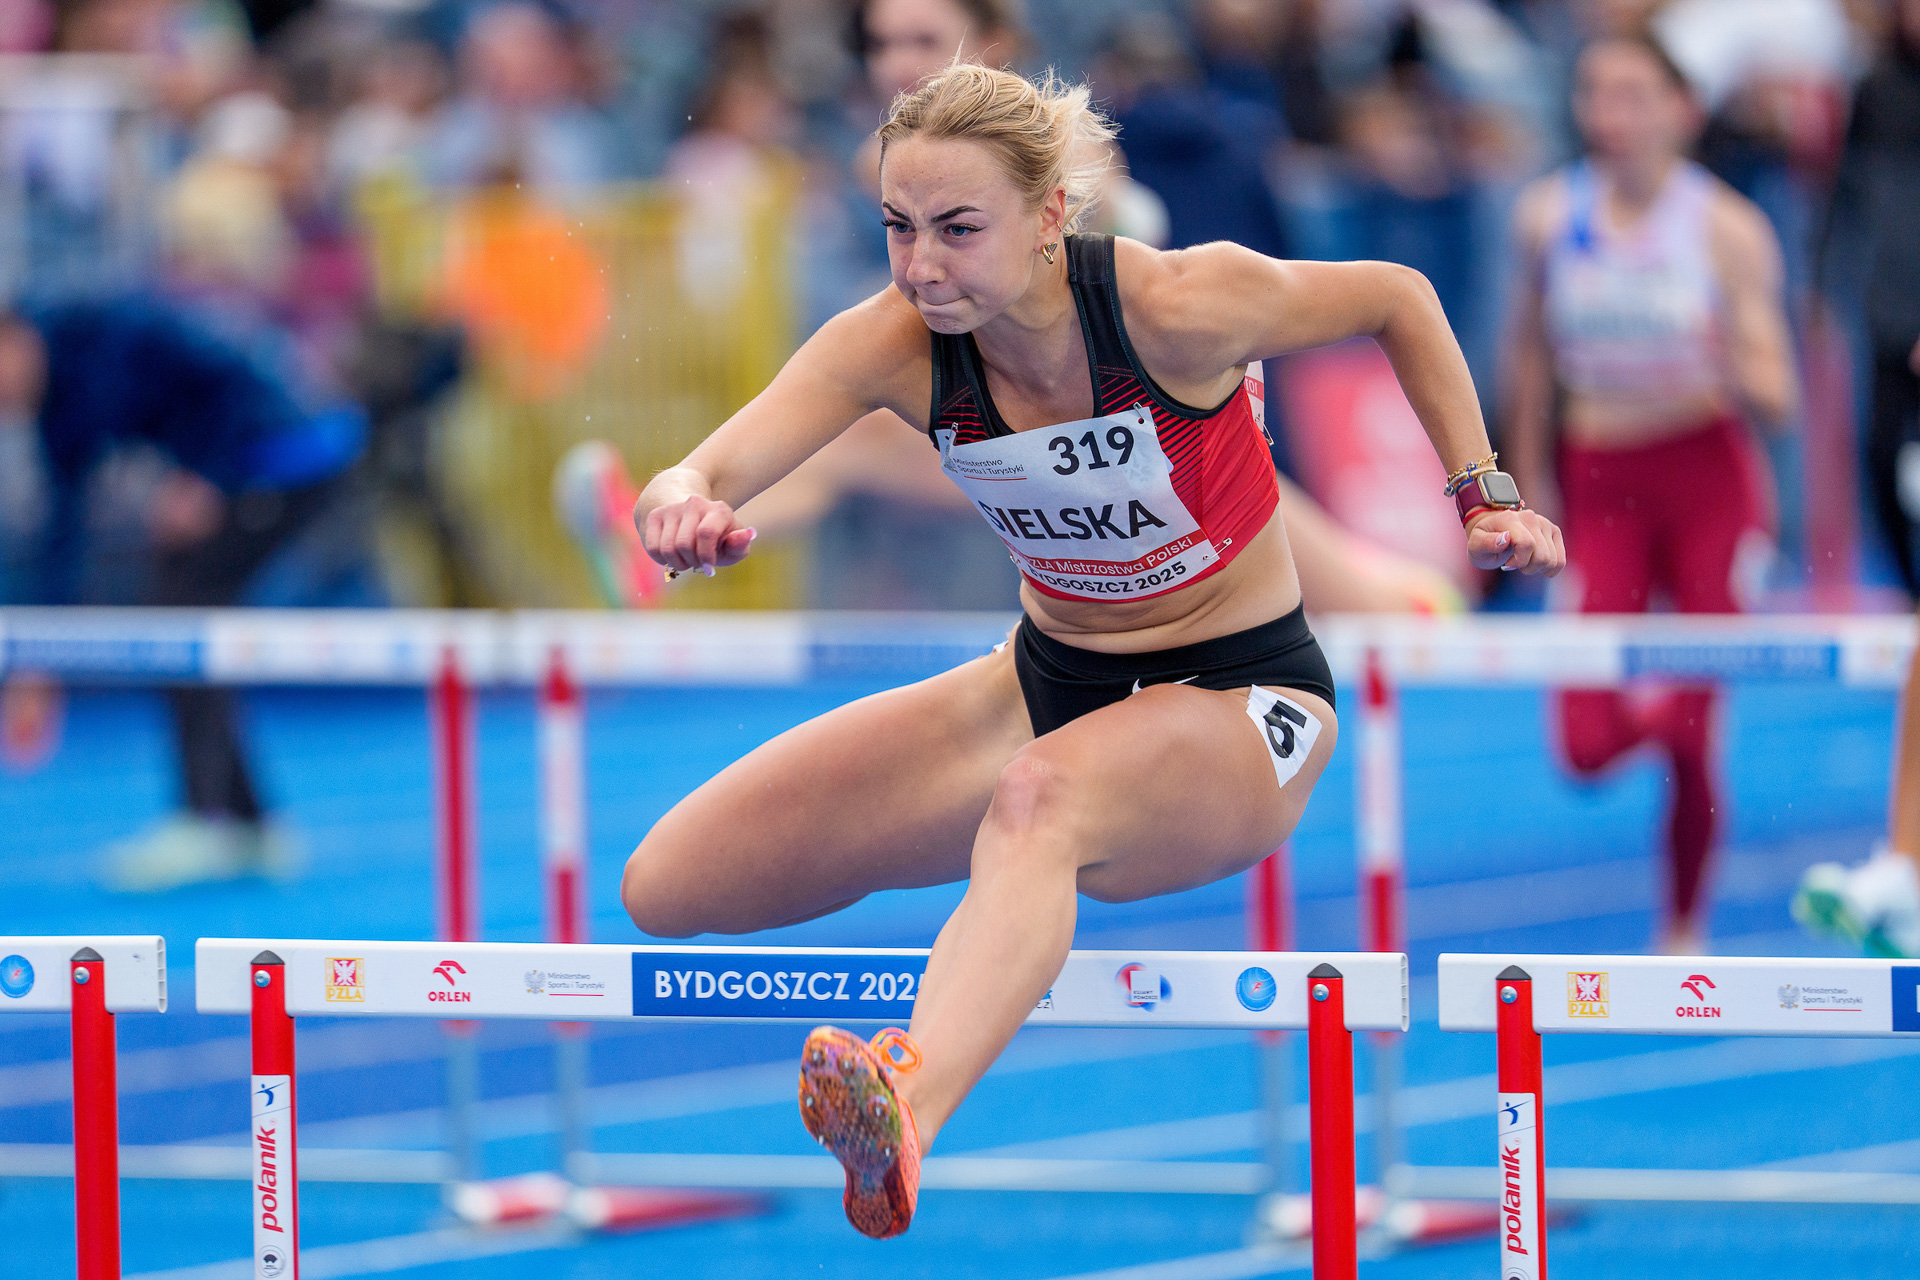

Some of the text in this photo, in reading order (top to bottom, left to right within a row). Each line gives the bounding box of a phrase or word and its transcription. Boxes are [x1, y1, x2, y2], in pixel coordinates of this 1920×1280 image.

[1048, 425, 1135, 476] 319
[952, 457, 1003, 468] Ministerstwo
[987, 464, 1025, 475] Turystyki
[978, 498, 1168, 540] SIELSKA
[1027, 535, 1194, 575] ZLA Mistrzostwa Polski
[1137, 560, 1187, 591] 2025
[547, 971, 591, 980] Ministerstwo
[547, 981, 570, 989] Sportu
[575, 981, 605, 990] Turystyki
[654, 969, 851, 1002] BYDGOSZCZ
[1802, 986, 1848, 995] Ministerstwo
[327, 987, 362, 1000] PZLA
[427, 990, 472, 1003] ORLEN
[1802, 996, 1825, 1004] Sportu
[1831, 996, 1863, 1005] Turystyki
[1571, 1002, 1607, 1015] PZLA
[1675, 1006, 1721, 1018] ORLEN
[256, 1124, 284, 1233] polanik
[1501, 1144, 1529, 1256] polanik
